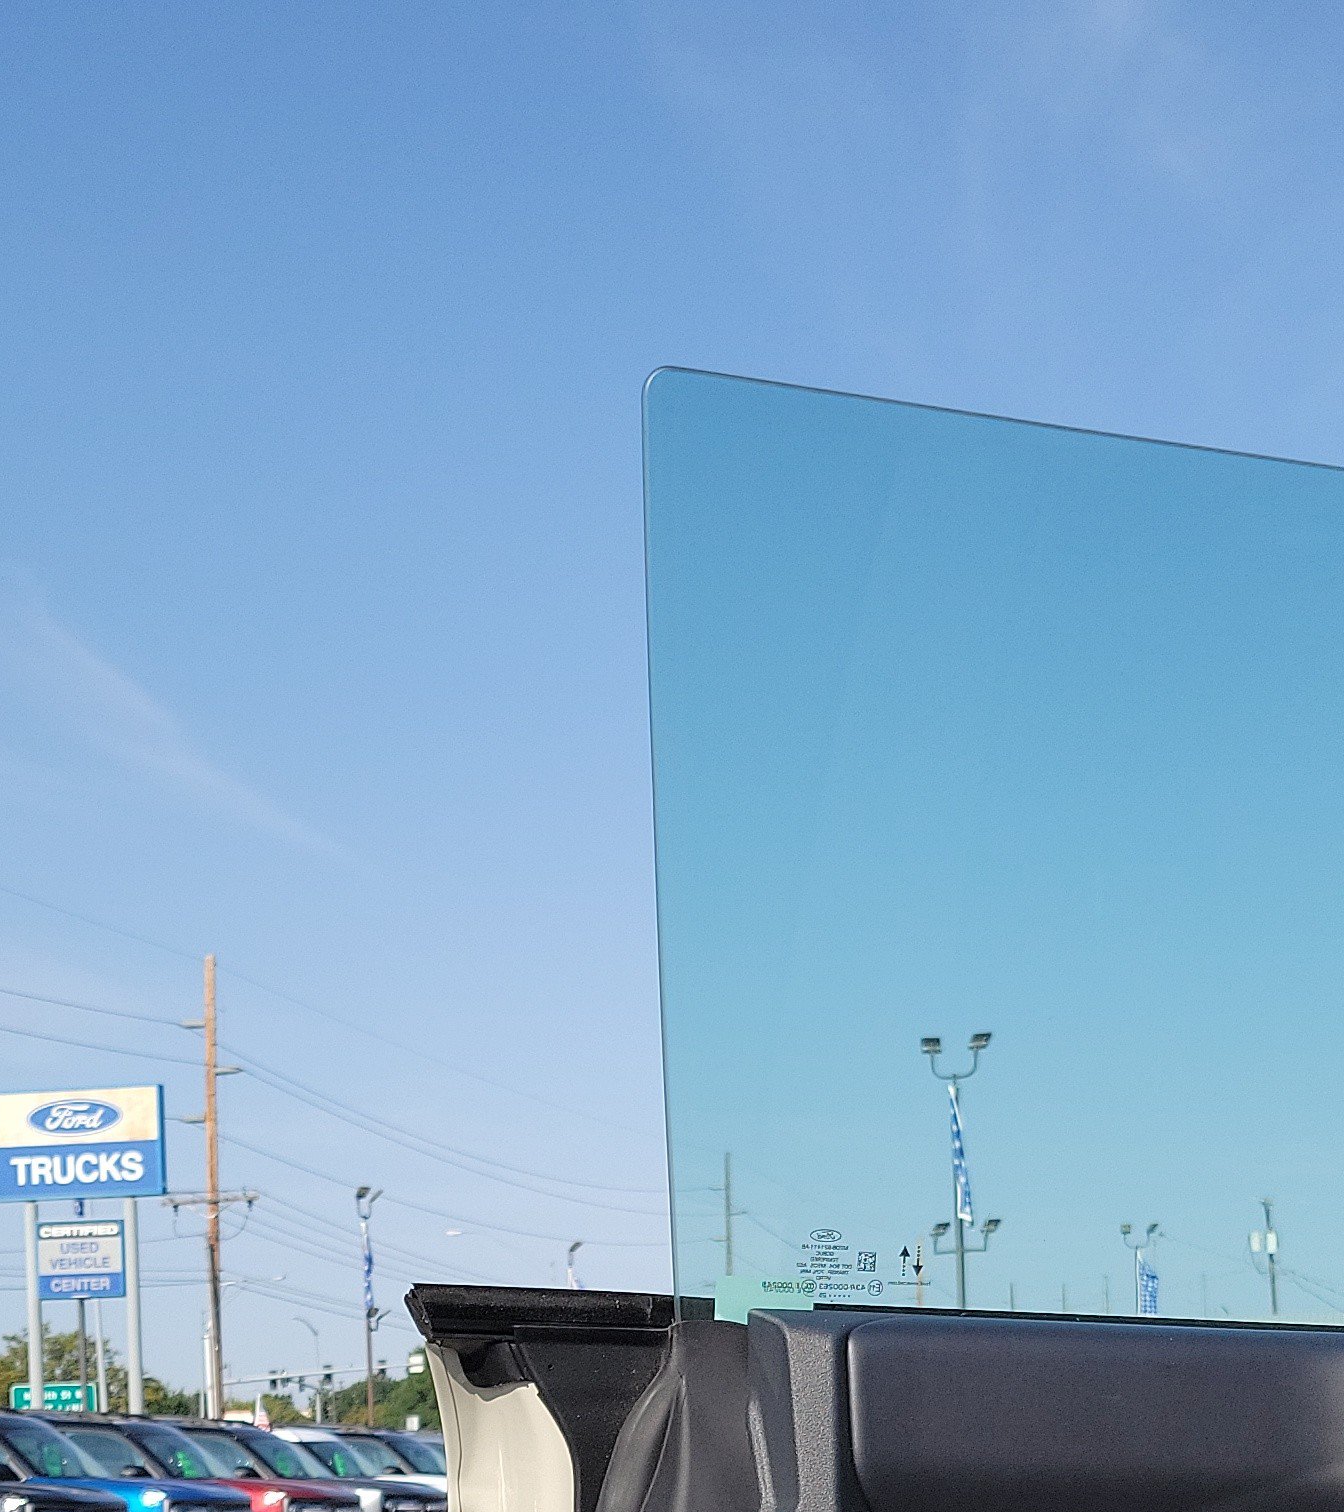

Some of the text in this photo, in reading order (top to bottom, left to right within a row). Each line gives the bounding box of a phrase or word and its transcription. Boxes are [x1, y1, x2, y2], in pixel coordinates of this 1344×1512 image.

[45, 1103, 104, 1131] Ford
[9, 1150, 144, 1187] TRUCKS
[60, 1242, 99, 1254] USED
[49, 1256, 110, 1269] VEHICLE
[50, 1277, 110, 1293] CENTER
